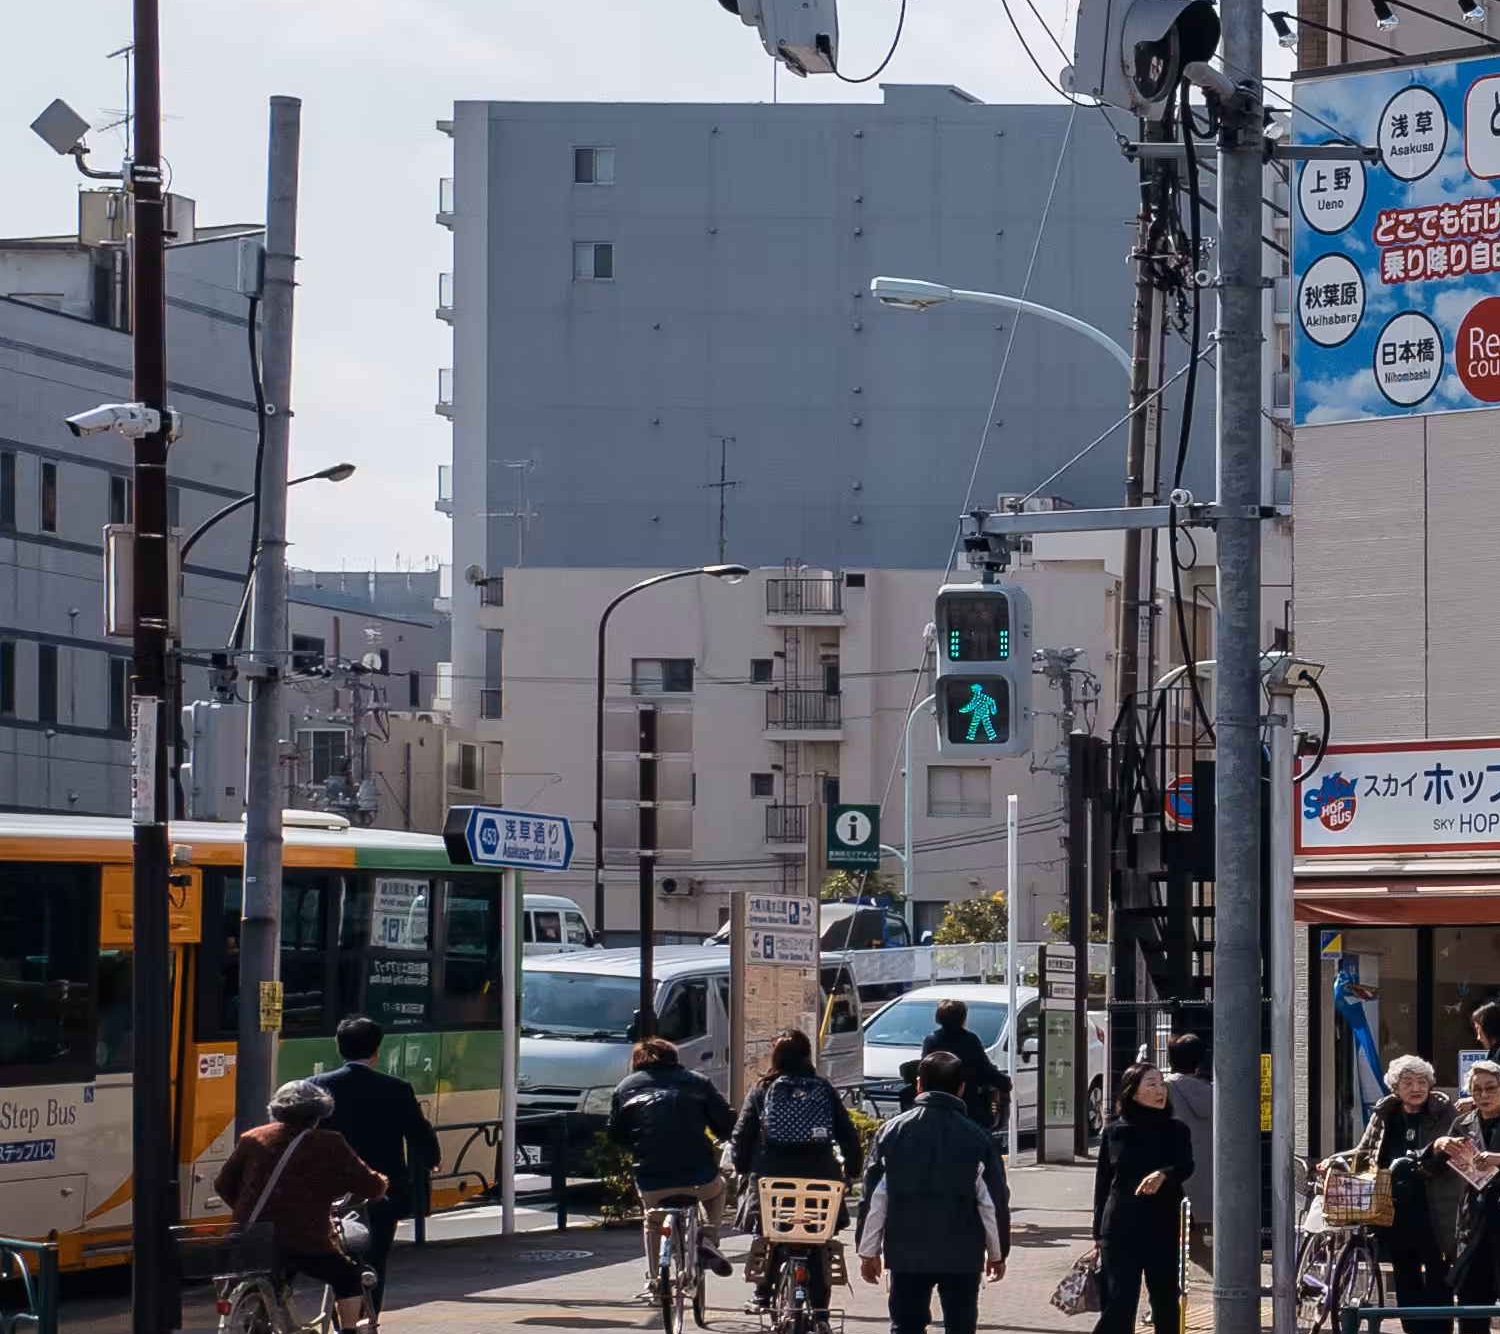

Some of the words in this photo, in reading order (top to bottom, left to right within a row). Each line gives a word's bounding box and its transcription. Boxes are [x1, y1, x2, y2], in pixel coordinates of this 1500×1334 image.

[1390, 111, 1434, 140] 浅草
[1390, 140, 1435, 157] Asakusa
[1310, 168, 1352, 195] 上野
[1317, 196, 1345, 212] Ueno
[1304, 281, 1358, 310] 秋葉原
[1305, 312, 1358, 330] Akihabara
[1382, 338, 1435, 367] 日本橋
[1384, 369, 1432, 384] Nihombashi
[1320, 802, 1346, 818] HOP
[1329, 811, 1353, 827] BUS
[504, 818, 559, 844] 浅草通り
[1433, 818, 1456, 832] SKY
[1460, 812, 1500, 834] HOP
[0, 1101, 40, 1134] Step
[46, 1098, 77, 1127] Bus
